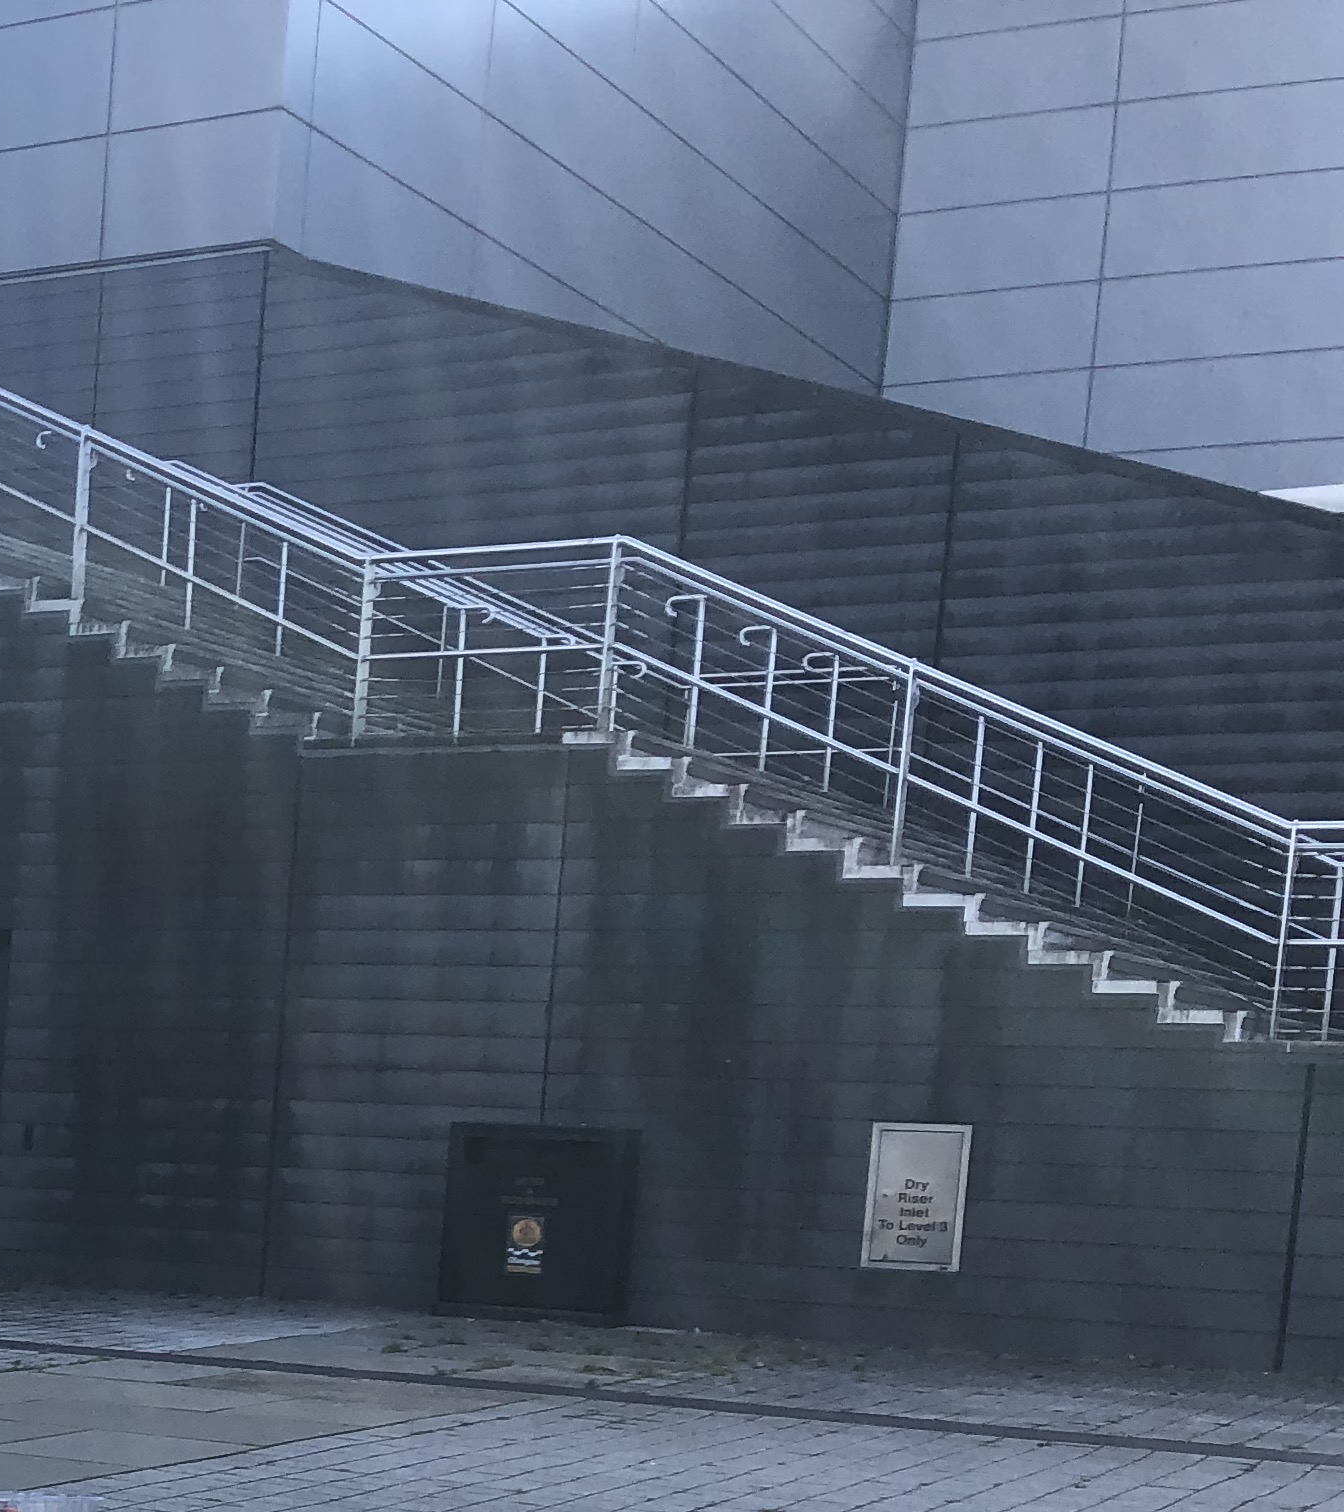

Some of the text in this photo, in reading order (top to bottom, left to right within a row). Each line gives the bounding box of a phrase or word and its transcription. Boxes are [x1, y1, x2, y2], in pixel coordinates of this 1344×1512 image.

[905, 1178, 930, 1192] Dry
[897, 1192, 934, 1204] Riser
[899, 1207, 930, 1218] Inlet
[878, 1219, 948, 1232] To Level 3
[896, 1234, 928, 1248] Only
